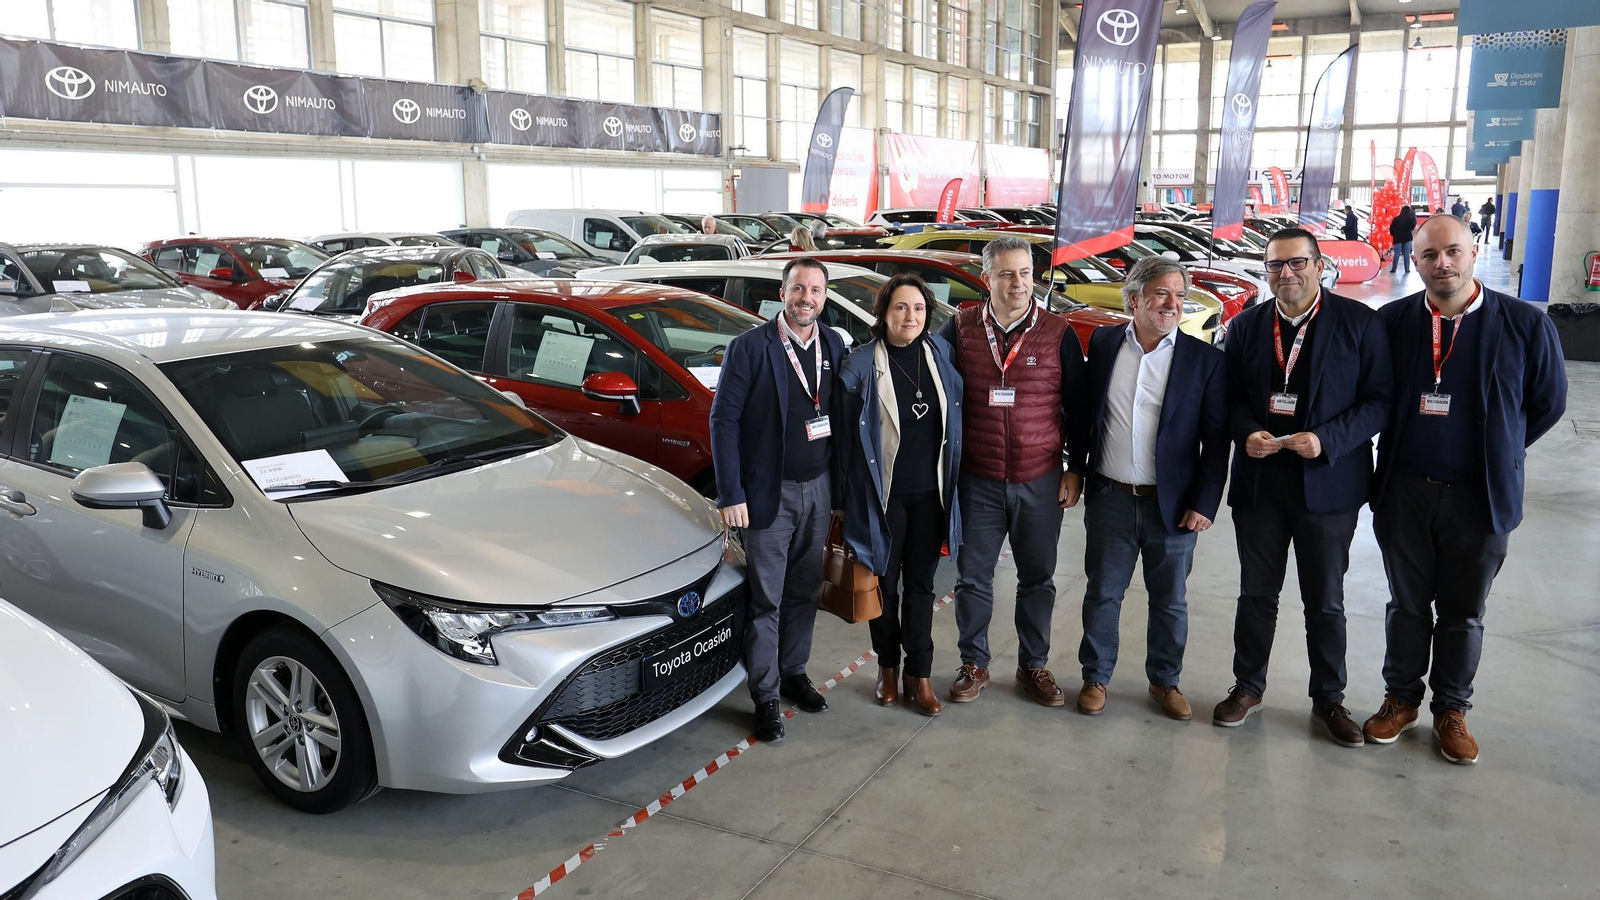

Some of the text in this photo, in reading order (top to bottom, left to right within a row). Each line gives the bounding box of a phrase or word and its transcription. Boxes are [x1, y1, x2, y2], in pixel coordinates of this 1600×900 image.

[1082, 54, 1147, 76] NIMAUTO
[104, 78, 167, 97] NIMAUTO
[285, 96, 336, 111] NIMAUTO
[426, 106, 467, 120] NIMAUTO
[535, 115, 568, 128] NIMAUTO
[831, 193, 858, 207] driveris
[942, 189, 954, 221] driveris
[265, 474, 302, 484] DESCUENTO
[191, 566, 219, 582] HYBRID
[652, 627, 732, 678] Toyota Ocasión
